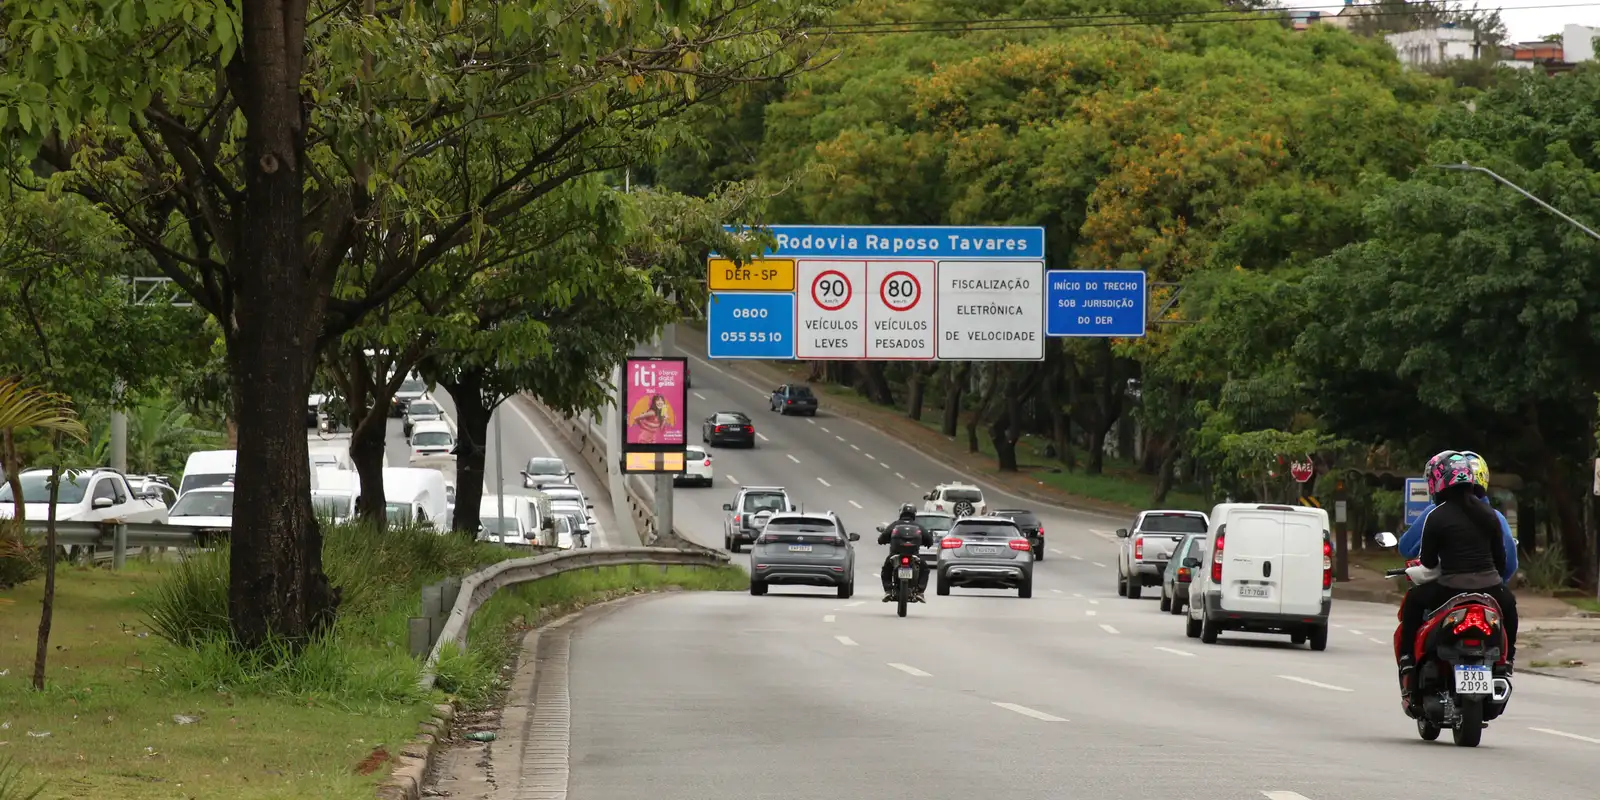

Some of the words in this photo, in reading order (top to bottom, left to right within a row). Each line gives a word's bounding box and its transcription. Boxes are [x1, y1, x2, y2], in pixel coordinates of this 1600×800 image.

[776, 233, 858, 250] Rodovia
[866, 234, 939, 252] Raposo
[948, 235, 1027, 250] Tavares
[819, 279, 845, 297] 90
[888, 280, 914, 297] 80
[952, 277, 1030, 291] FISCALIZAÇÃO
[1053, 279, 1080, 291] INÍCIO
[1085, 282, 1098, 291] DO
[1103, 282, 1138, 291] TRECHO
[957, 302, 1023, 315] ELETRÔNICA
[1058, 299, 1076, 307] SOB
[1082, 297, 1134, 309] JURISDIÇÃO
[733, 308, 768, 318] 0800
[805, 317, 858, 330] VEÍCULOS
[875, 317, 927, 330] VEÍCULOS
[1078, 316, 1090, 325] DO
[1095, 316, 1113, 325] DER
[946, 331, 959, 341] DE
[968, 331, 1036, 341] VELOCIDADE
[815, 339, 848, 349] LEVES
[876, 339, 925, 349] PESADOS
[634, 363, 656, 387] iti
[1292, 461, 1311, 472] PARE
[1463, 671, 1484, 681] BXD
[1460, 681, 1488, 691] 2D98
